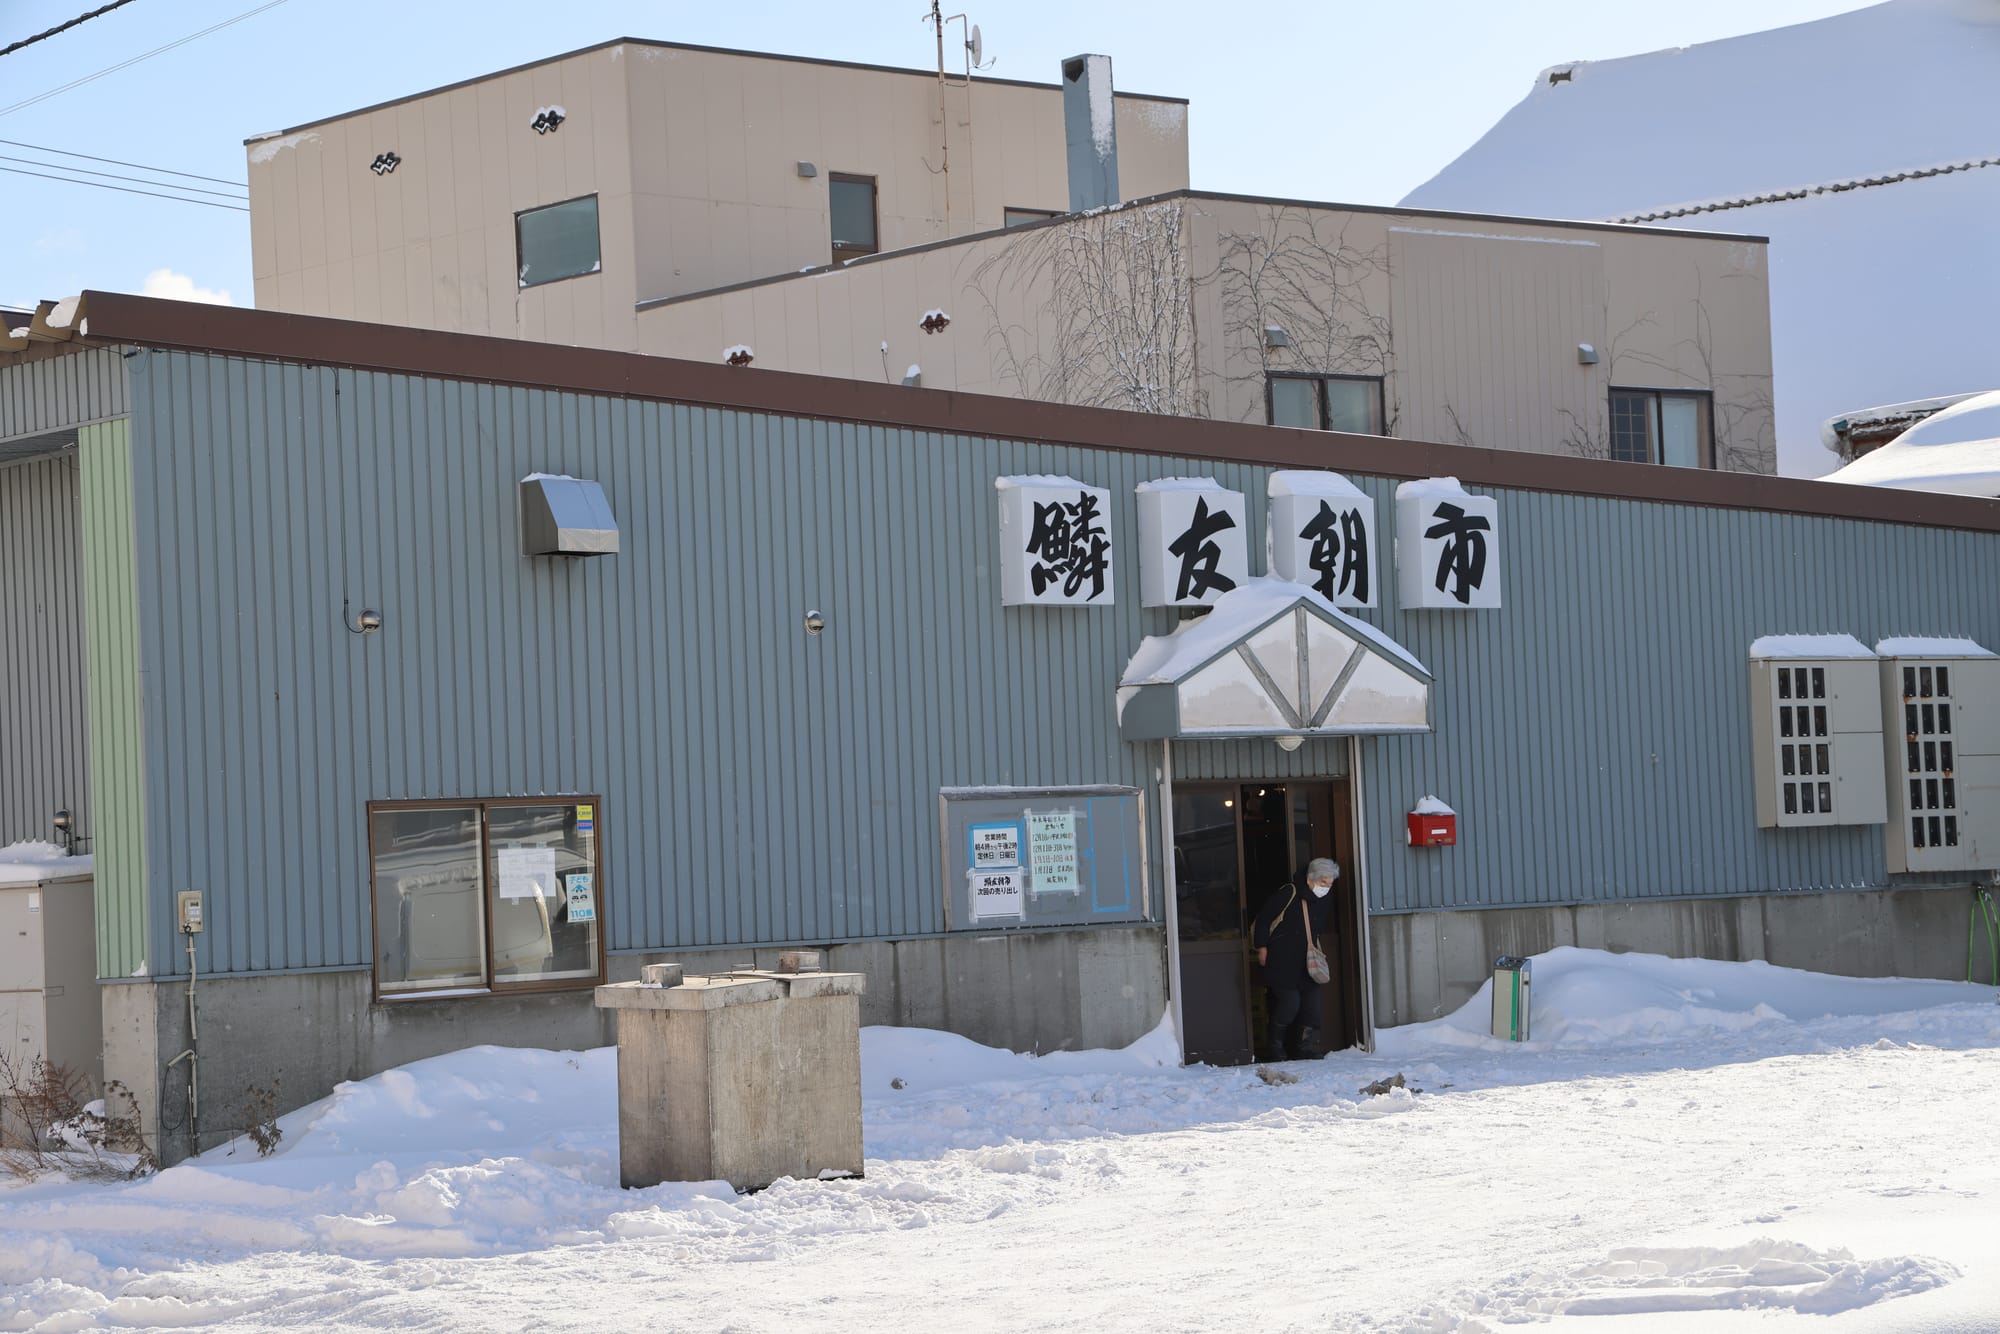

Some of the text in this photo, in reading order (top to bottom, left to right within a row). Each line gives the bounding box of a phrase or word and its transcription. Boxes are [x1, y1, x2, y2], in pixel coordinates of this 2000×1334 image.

[1026, 490, 1491, 604] 鱗友朝市
[984, 833, 1007, 841] 営業時間
[977, 851, 1016, 860] 定休日 日曜日
[977, 887, 1018, 895] 次回の売り出し
